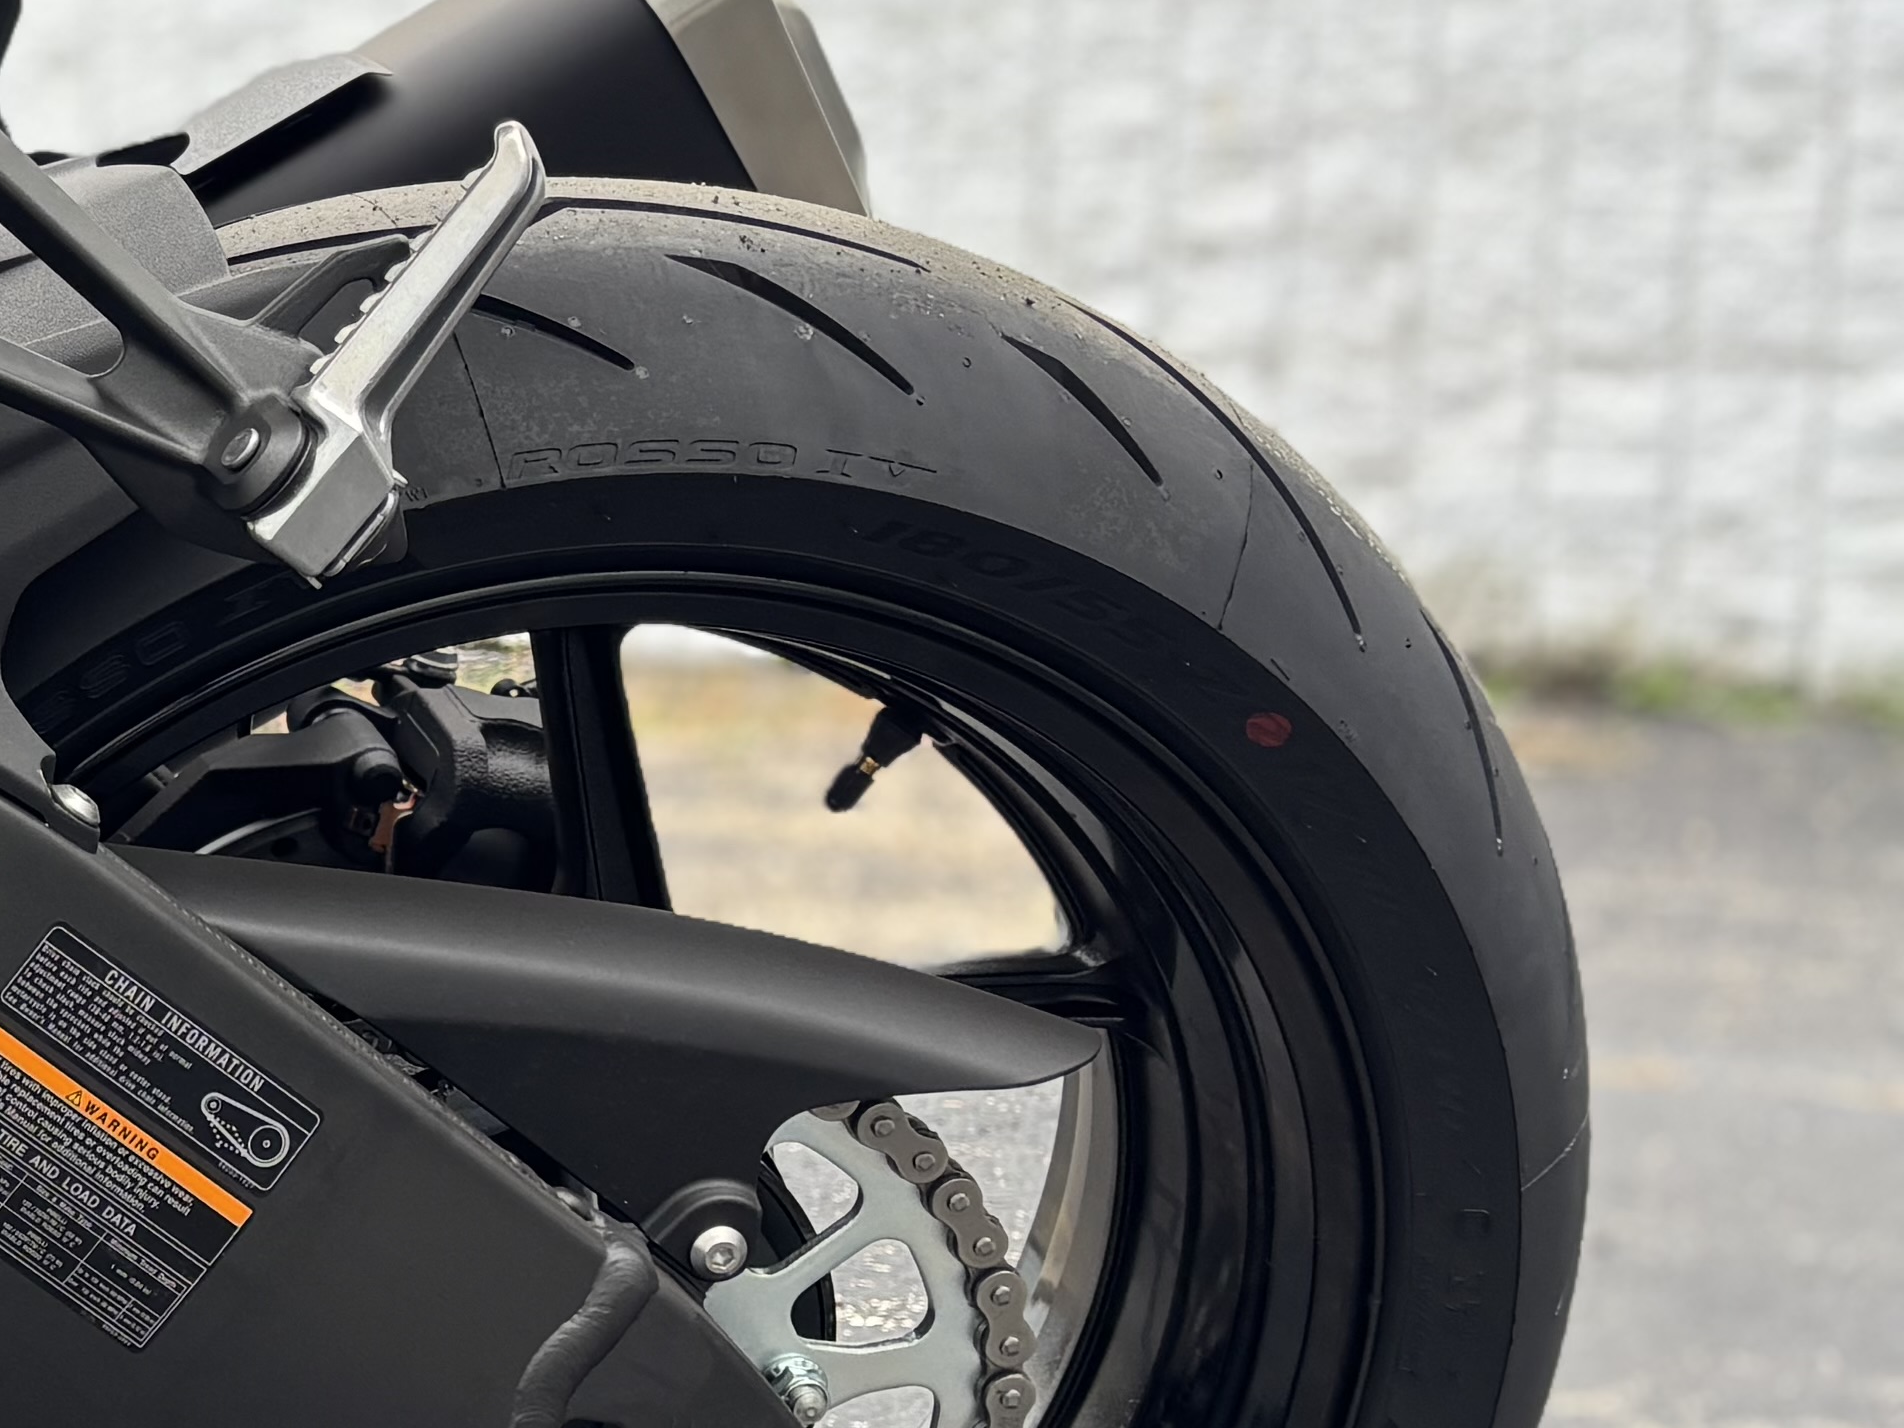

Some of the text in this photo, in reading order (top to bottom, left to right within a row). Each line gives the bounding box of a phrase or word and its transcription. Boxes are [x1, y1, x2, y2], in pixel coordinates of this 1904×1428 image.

[505, 438, 798, 480] ROSSO
[101, 967, 267, 1092] CHAIN INFORMATION
[2, 1104, 39, 1135] Manual
[35, 1128, 53, 1145] for
[49, 1138, 97, 1176] additional
[92, 1169, 149, 1214] information.
[3, 1091, 39, 1120] control
[33, 1114, 74, 1148] causing
[70, 1139, 108, 1170] serious
[102, 1163, 136, 1192] bodily
[129, 1183, 163, 1211] injury.
[7, 1080, 66, 1128] replacement
[62, 1119, 87, 1141] tires
[82, 1136, 97, 1149] or
[92, 1142, 150, 1188] overloading
[144, 1181, 165, 1198] can
[161, 1191, 192, 1217] result
[19, 1074, 44, 1095] with
[38, 1089, 84, 1126] improper
[79, 1118, 120, 1150] inflation
[115, 1145, 130, 1158] or
[126, 1151, 174, 1189] excessive
[167, 1184, 196, 1208] wear,
[81, 1099, 161, 1162] WARNING
[26, 1151, 62, 1182] AND
[59, 1174, 102, 1211] LOAD
[99, 1203, 140, 1238] DATA
